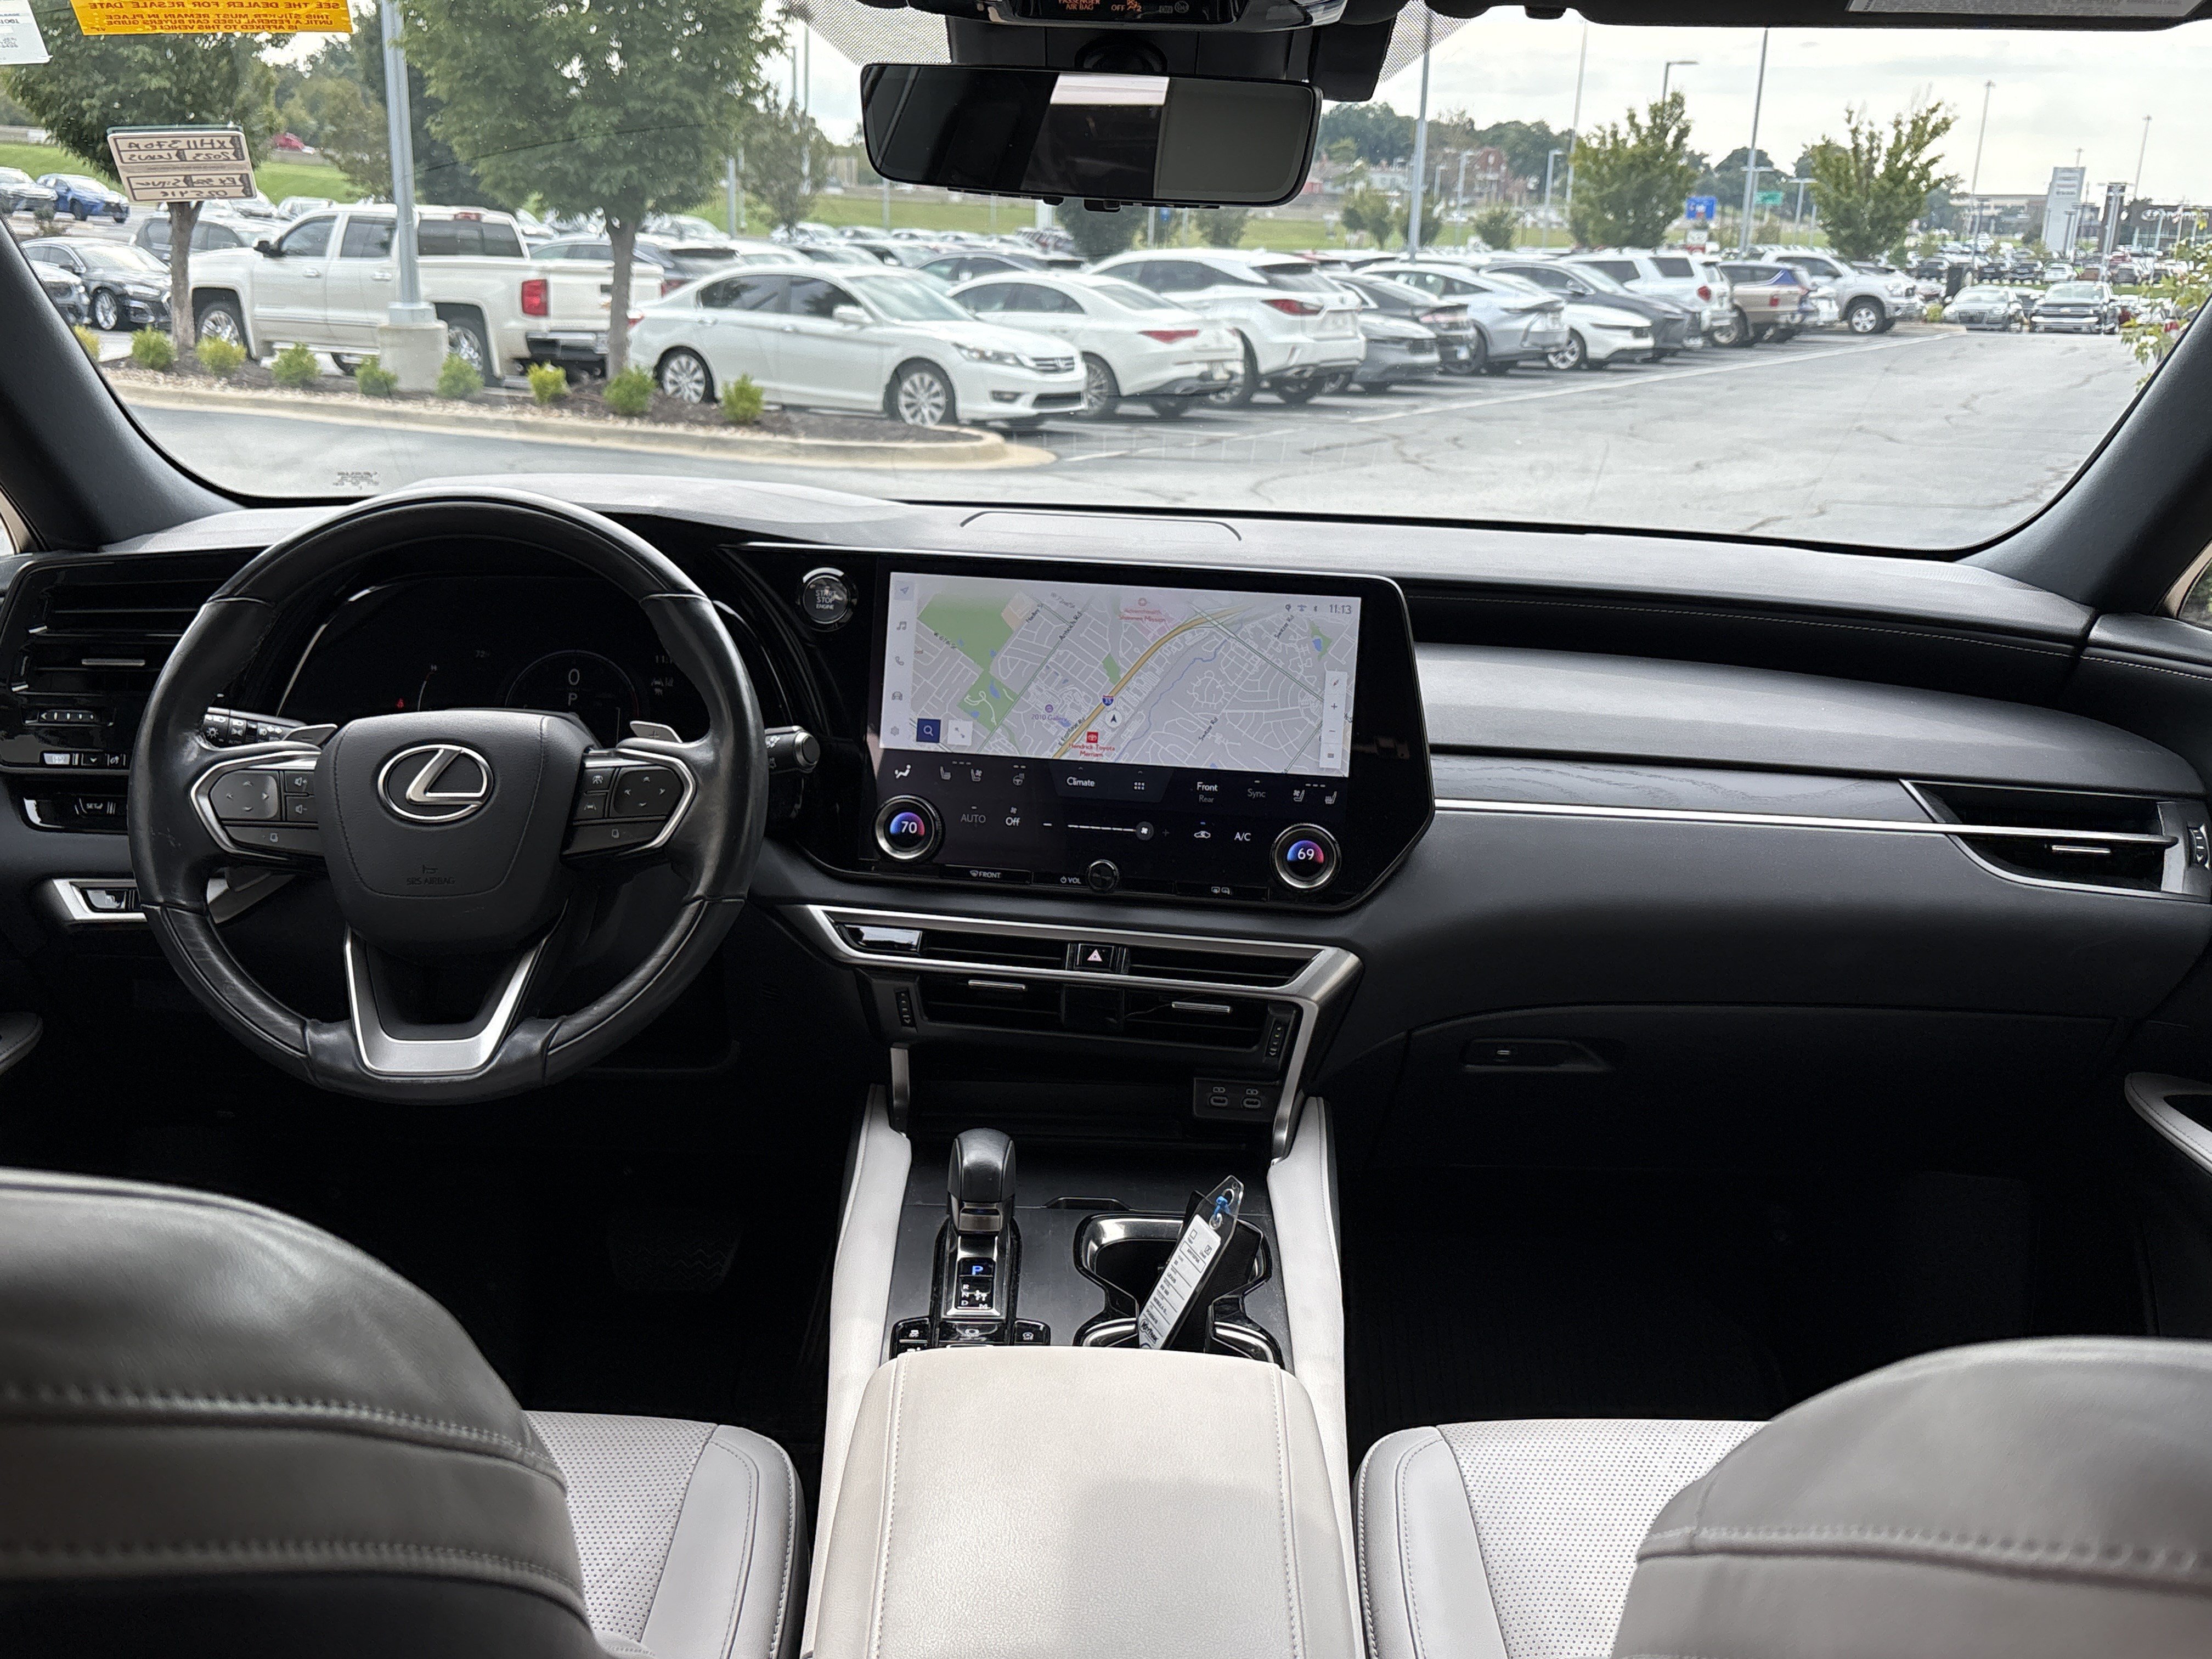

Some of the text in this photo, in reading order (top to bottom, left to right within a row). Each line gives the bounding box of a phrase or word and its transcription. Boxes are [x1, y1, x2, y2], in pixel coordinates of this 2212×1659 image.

[1329, 604, 1352, 614] 11:13
[568, 692, 578, 706] P
[1066, 776, 1096, 787] Climate
[1197, 781, 1218, 792] Front
[1199, 794, 1214, 803] Rear
[1247, 788, 1266, 799] Sync
[960, 814, 986, 824] AUTO
[1005, 817, 1021, 827] Off
[901, 821, 918, 834] 70
[1234, 832, 1251, 842] A/C
[1297, 848, 1314, 860] 69
[972, 1265, 984, 1276] P
